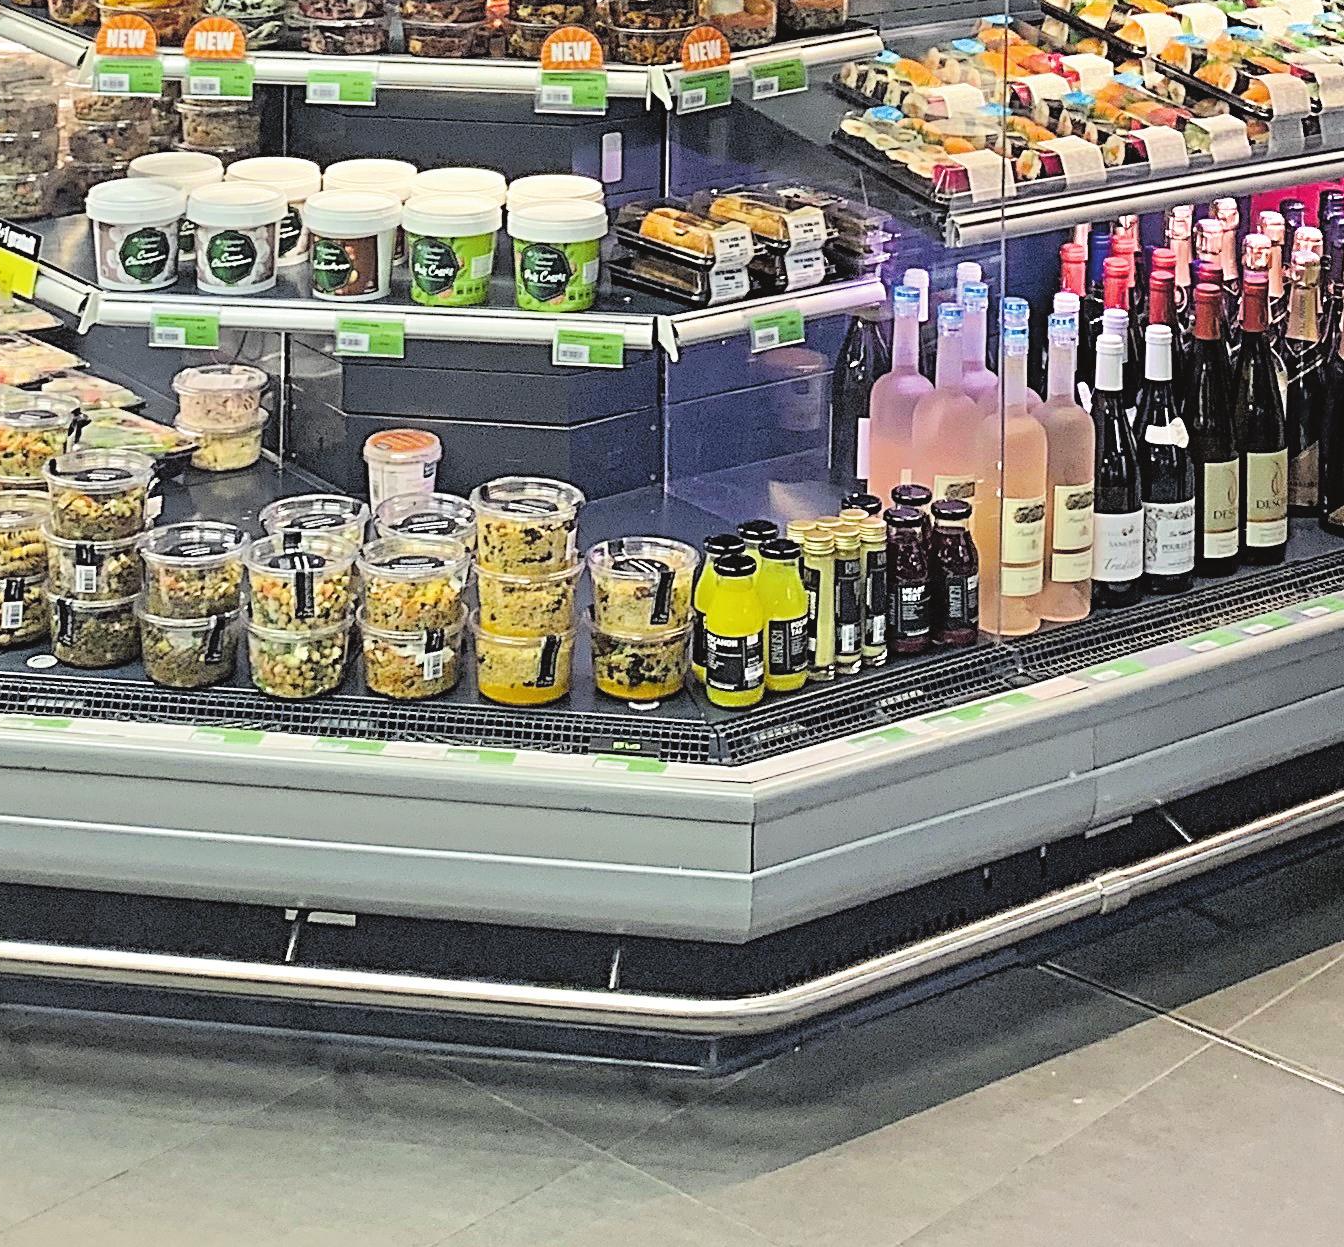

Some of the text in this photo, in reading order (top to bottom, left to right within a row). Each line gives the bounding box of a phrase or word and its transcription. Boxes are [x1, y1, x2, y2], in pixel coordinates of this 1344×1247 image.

[106, 28, 148, 49] NEW
[194, 30, 235, 51] NEW
[551, 41, 591, 62] NEW
[689, 39, 721, 62] NEW
